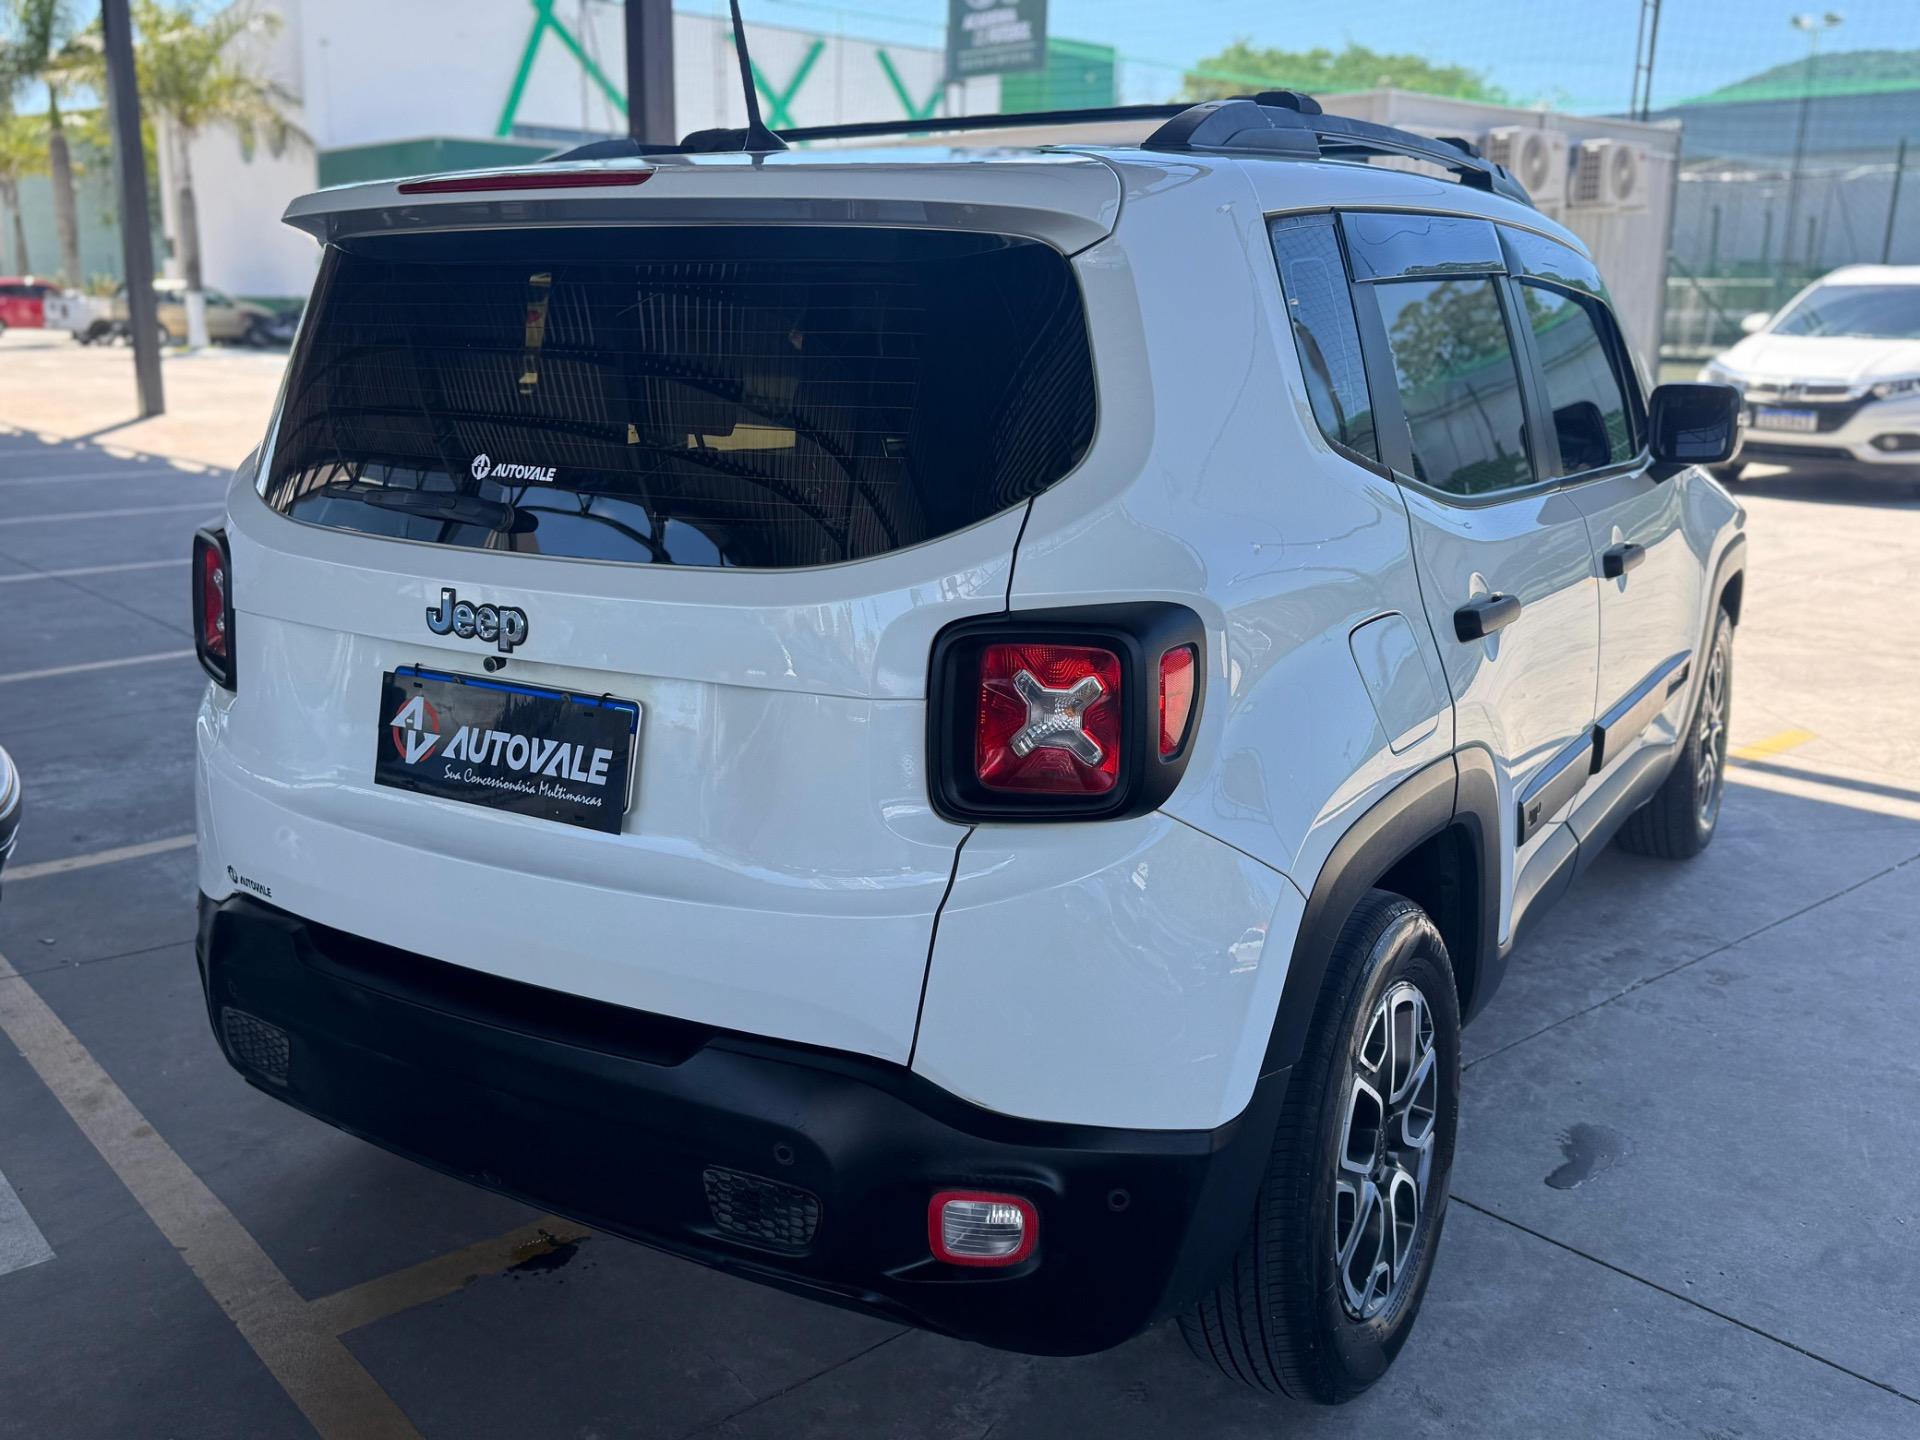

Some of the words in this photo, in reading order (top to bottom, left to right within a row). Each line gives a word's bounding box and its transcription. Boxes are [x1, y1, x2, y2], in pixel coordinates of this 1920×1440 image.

[491, 463, 557, 482] AUTOVALE
[426, 587, 529, 653] Jeep
[441, 726, 613, 786] AUTOVALE
[443, 764, 462, 780] Sua
[539, 780, 603, 807] Multimarcas
[240, 876, 272, 898] AUTOVALE
